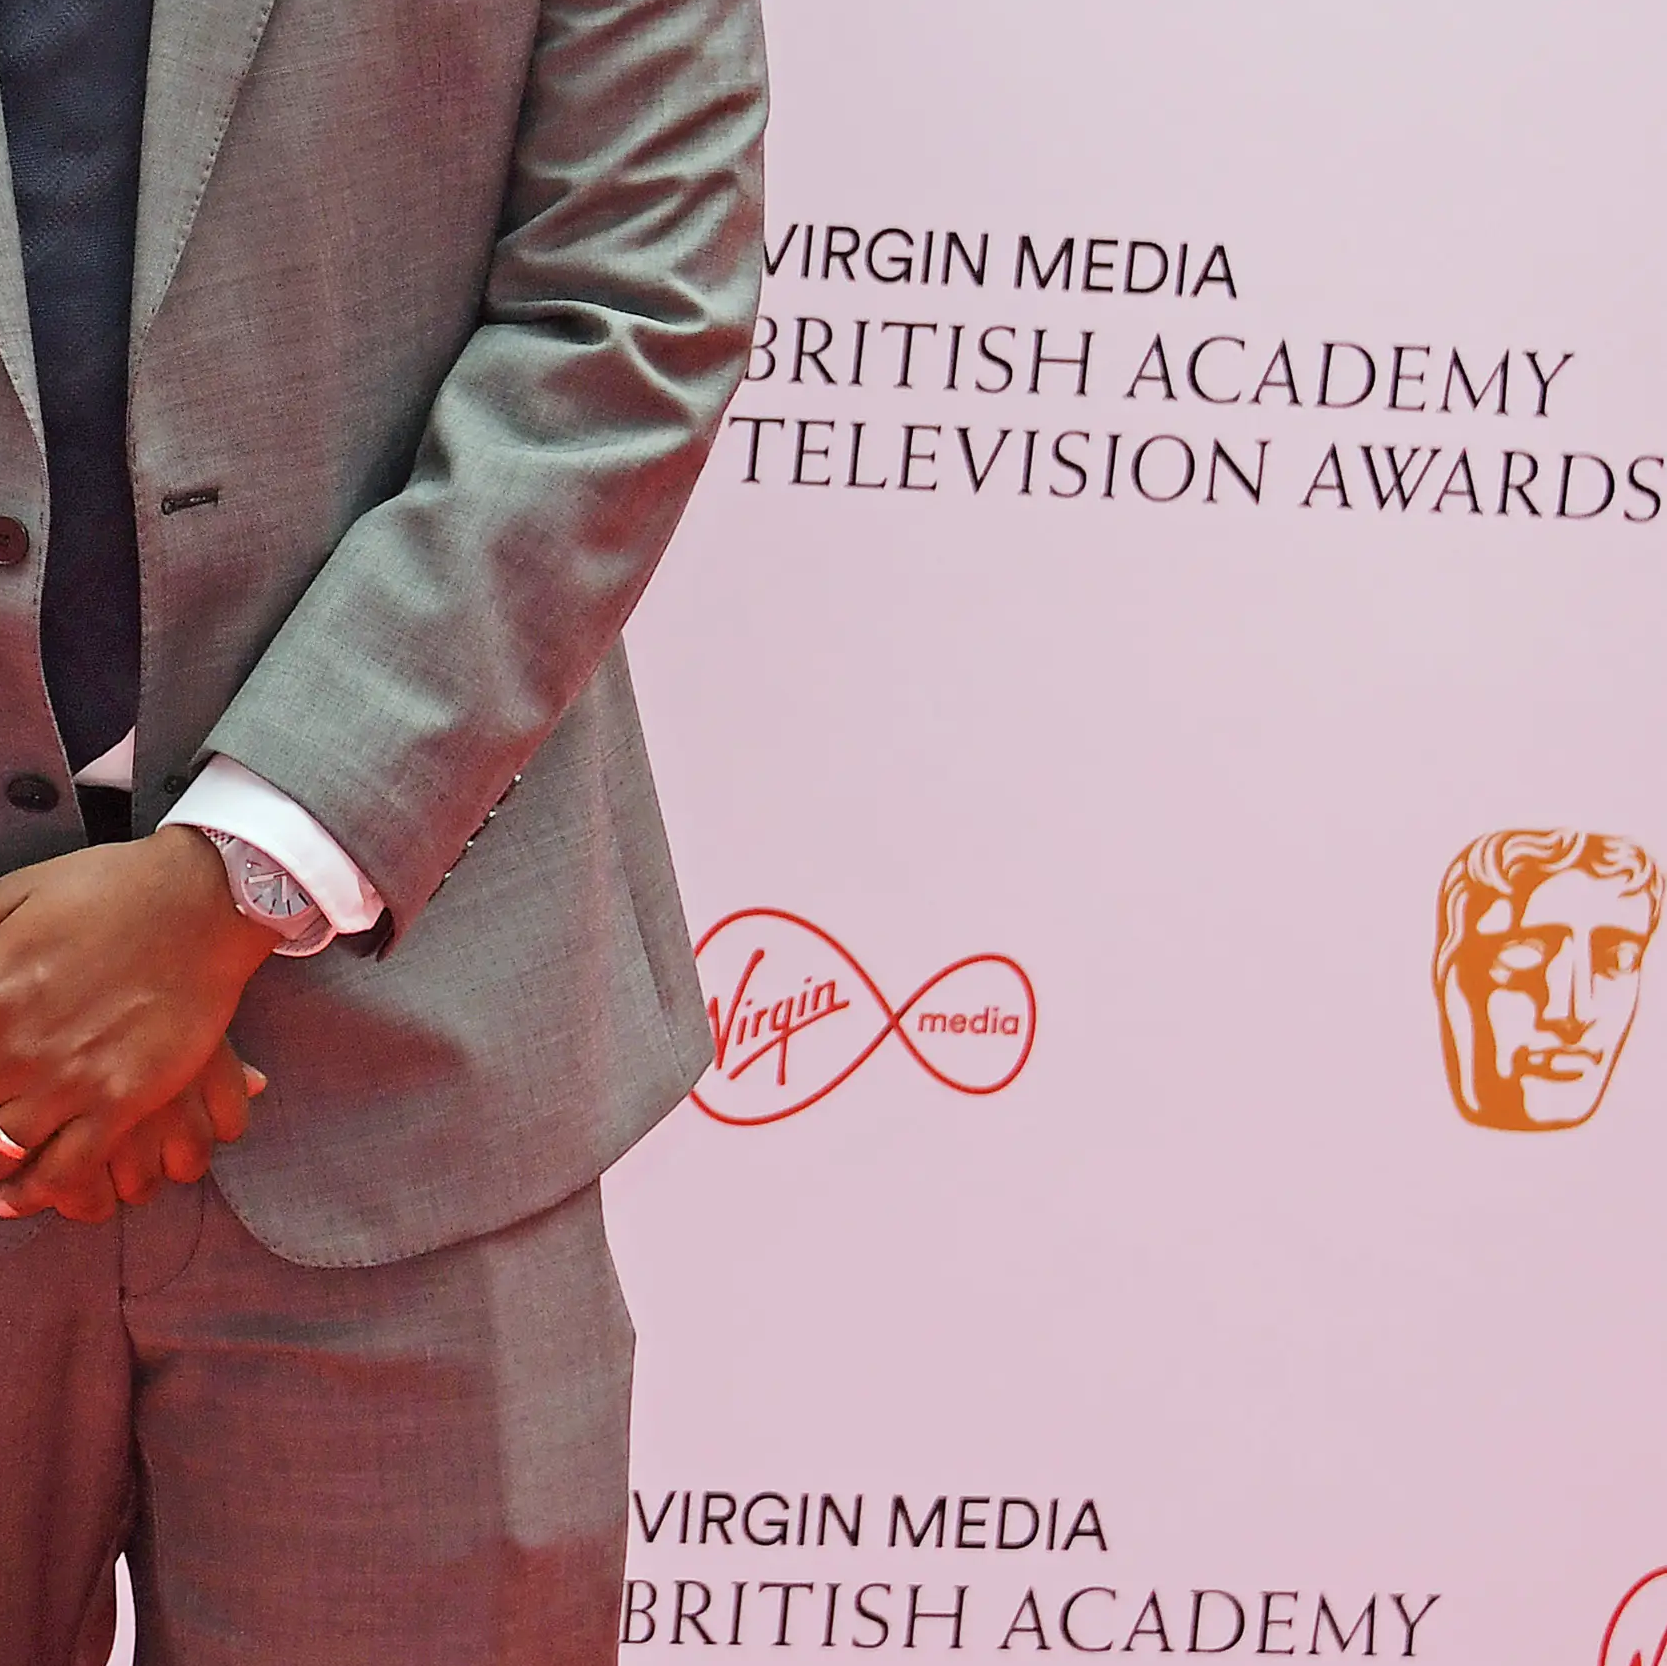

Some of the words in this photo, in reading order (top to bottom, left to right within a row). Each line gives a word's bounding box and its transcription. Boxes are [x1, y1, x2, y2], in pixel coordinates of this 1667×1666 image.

[764, 223, 989, 287] VIRGIN
[1014, 235, 1237, 299] MEDIA
[744, 315, 1094, 397] BRITISH
[1124, 333, 1574, 417] ACADEMY
[728, 416, 1271, 505] TELEVISION
[1300, 443, 1664, 523] AWARDS
[708, 948, 850, 1086] Virgin
[918, 1007, 1019, 1035] media
[633, 1490, 863, 1547] VIRGIN
[888, 1495, 1108, 1552] MEDIA
[620, 1579, 969, 1649] BRITISH
[997, 1587, 1441, 1657] ACADEMY
